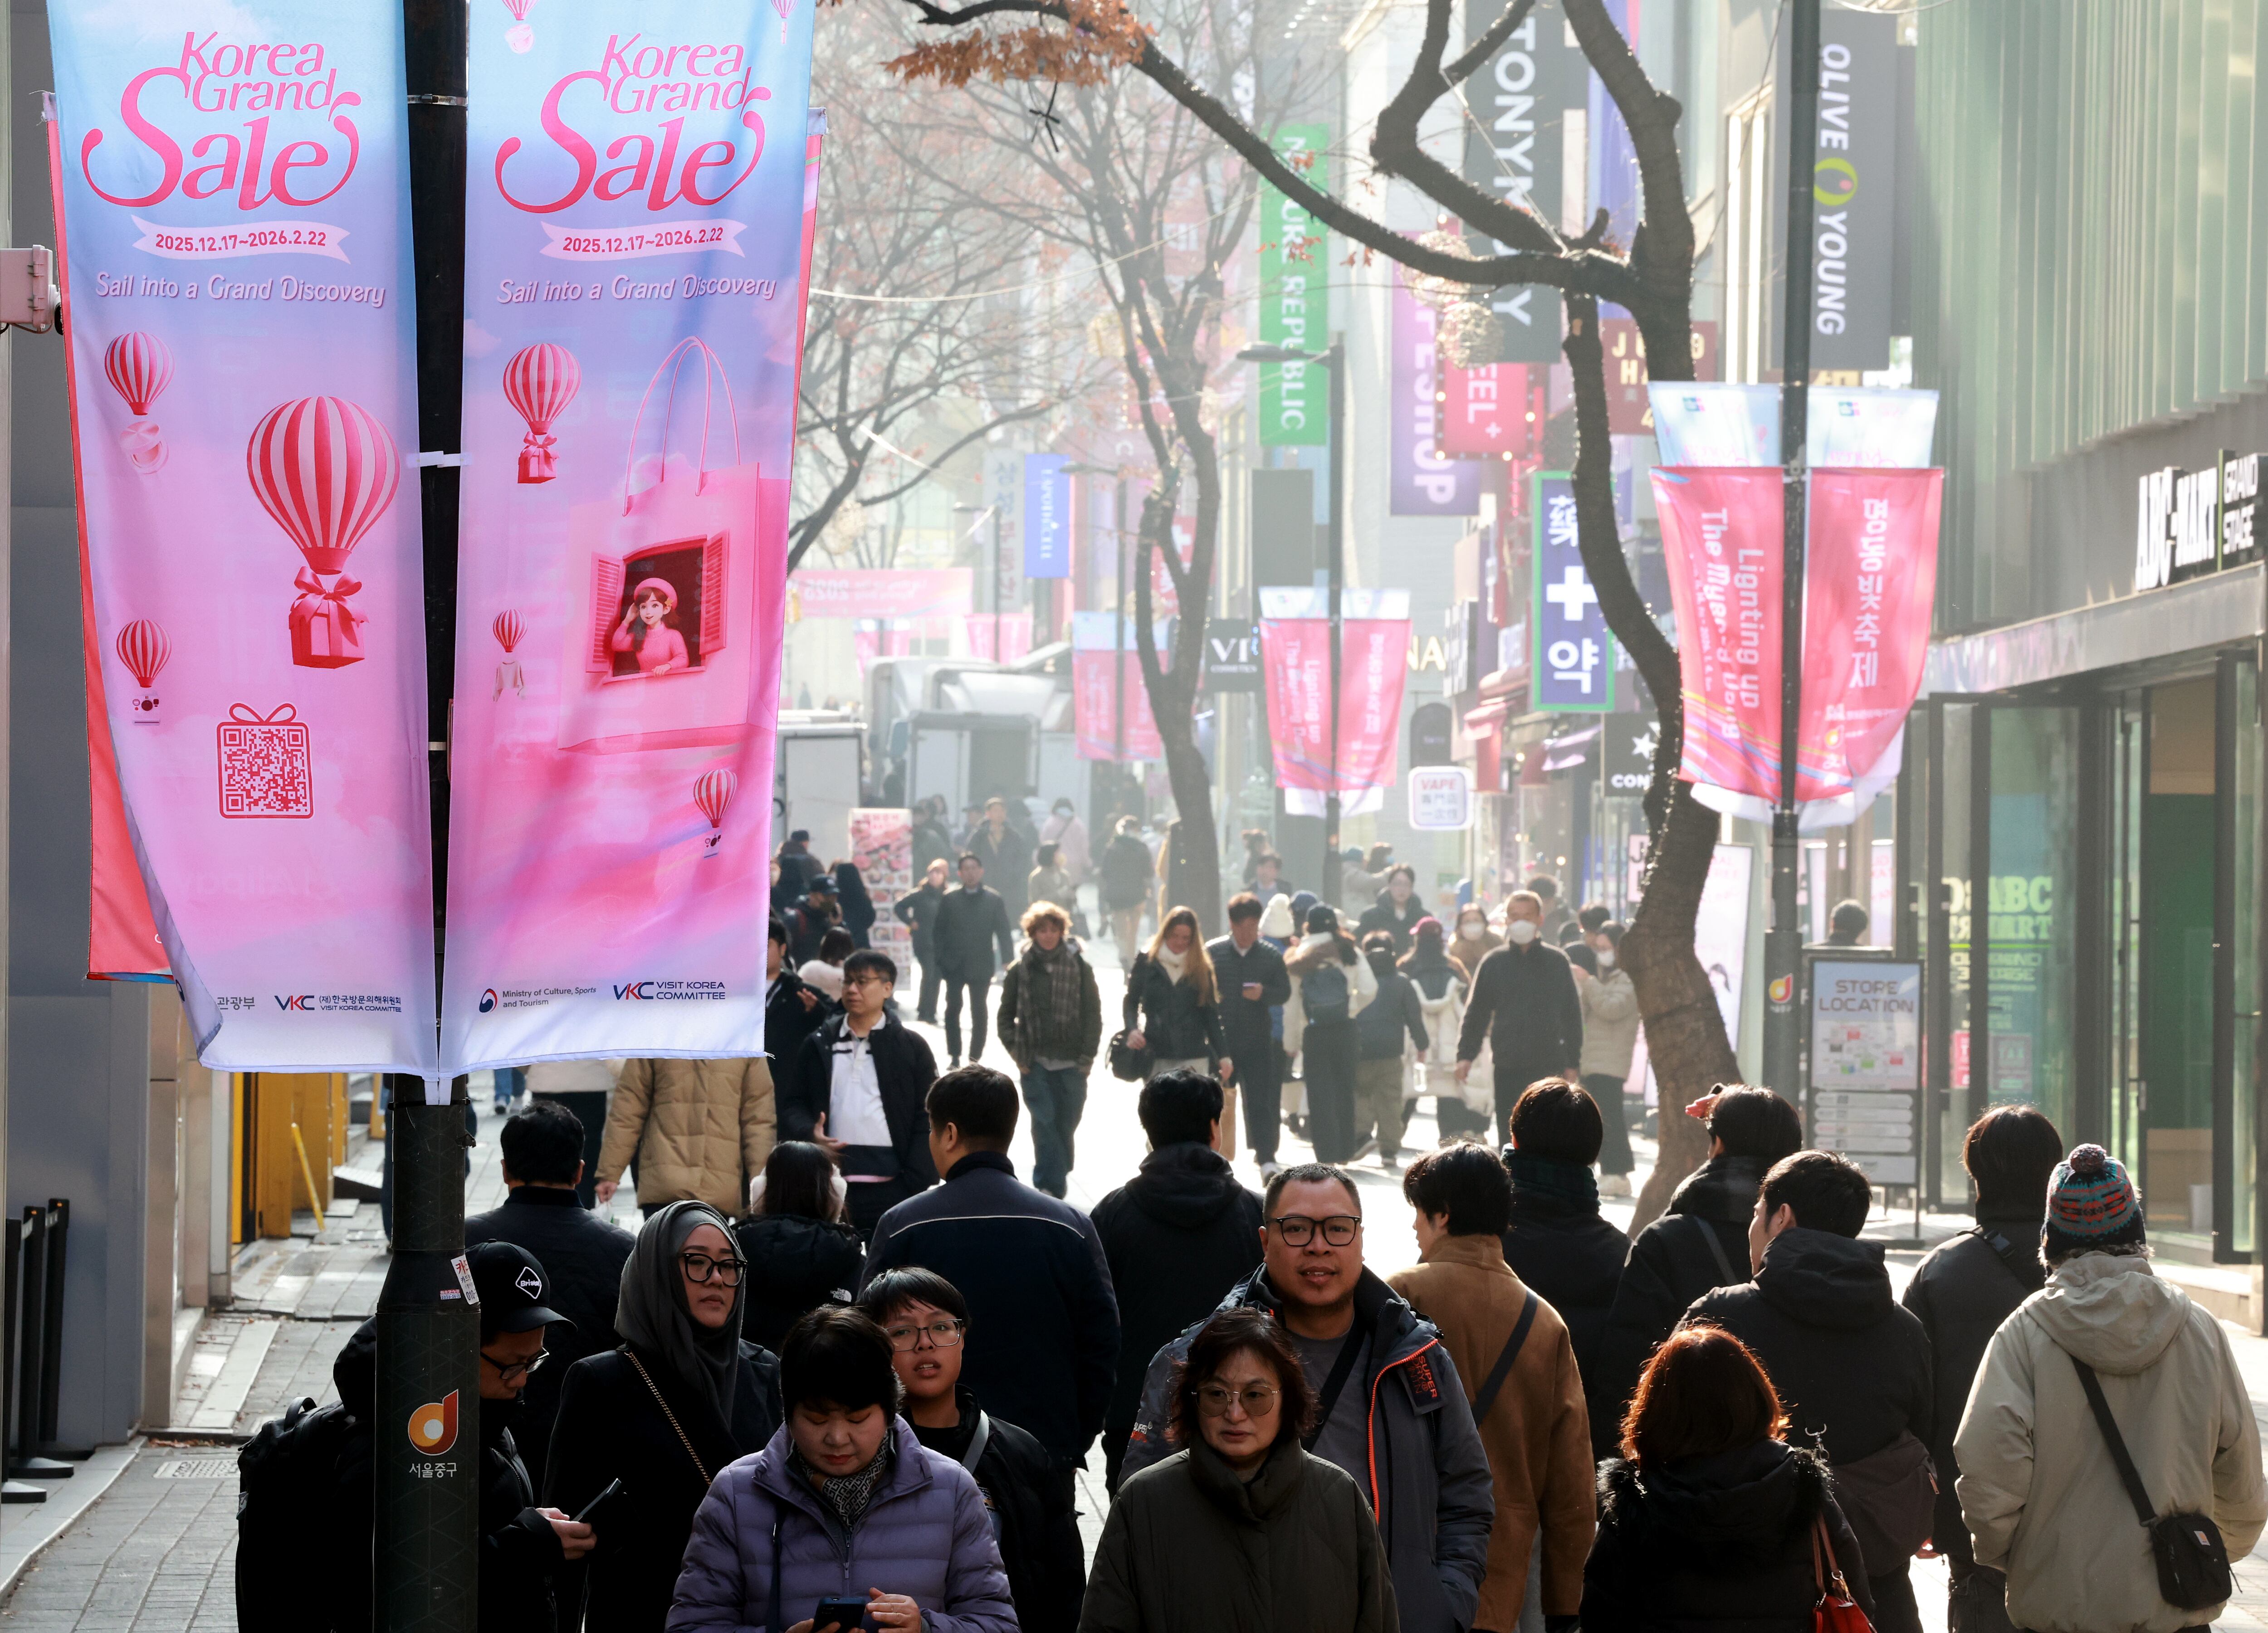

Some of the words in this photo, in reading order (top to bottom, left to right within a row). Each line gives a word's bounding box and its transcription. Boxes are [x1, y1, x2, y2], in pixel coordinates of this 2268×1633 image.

[180, 31, 325, 77] Korea
[600, 33, 744, 78] Korea
[193, 68, 337, 112] Grand
[611, 66, 751, 113] Grand
[1820, 43, 1851, 150] OLIVE
[81, 67, 359, 210] Sale
[495, 70, 765, 213] Sale
[156, 230, 326, 252] 2025.12.17~2026.2.22
[563, 227, 723, 253] 2025.12.17~2026.2.22
[497, 278, 538, 303] Sail
[543, 280, 582, 301] into
[589, 286, 602, 299] a
[611, 275, 675, 299] Grand
[683, 273, 777, 300] Discovery
[1816, 210, 1848, 336] YOUNG
[96, 272, 133, 297] Sail
[140, 275, 179, 298] into
[186, 283, 198, 299] a
[207, 273, 273, 300] Grand
[281, 276, 386, 308] Discovery
[1701, 508, 1728, 556] The
[1407, 636, 1446, 671] NA
[1548, 638, 1599, 694] 약
[1421, 778, 1457, 790] VAPE
[1611, 774, 1650, 788] CON
[217, 996, 255, 1010] 관광부
[274, 995, 315, 1010] VKC
[503, 990, 532, 999] Ministry
[575, 987, 596, 995] Sports
[613, 982, 654, 1000] VKC
[657, 992, 725, 1000] COMMITTEE
[1836, 980, 1898, 995] STORE
[1818, 997, 1913, 1013] LOCATION
[1418, 1355, 1438, 1398] SUPER
[409, 1462, 457, 1478] 서울중구
